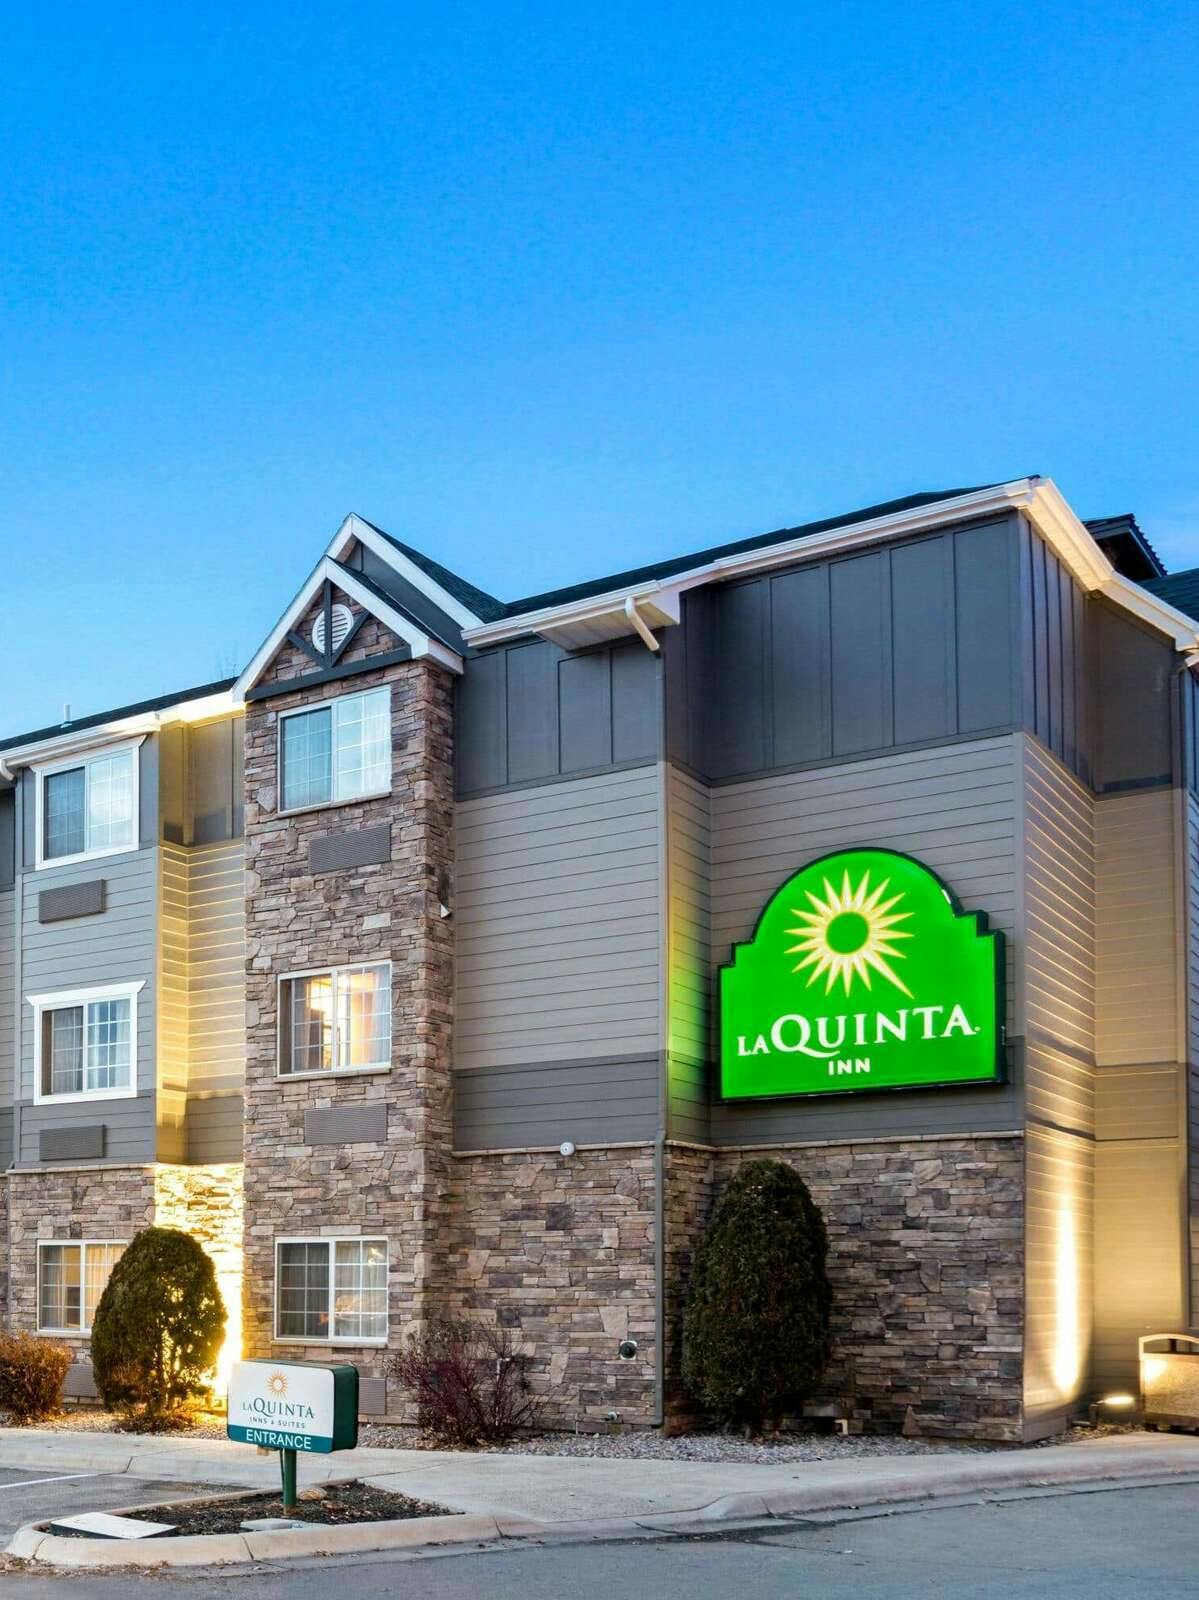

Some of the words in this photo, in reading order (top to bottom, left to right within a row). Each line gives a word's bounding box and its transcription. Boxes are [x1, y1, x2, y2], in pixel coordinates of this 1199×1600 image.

[737, 1035, 770, 1056] LA
[828, 1058, 871, 1075] INN
[253, 1397, 314, 1419] QUINTA
[249, 1416, 268, 1425] INNS
[278, 1419, 305, 1429] SUITES
[246, 1429, 312, 1450] ENTRANCE
